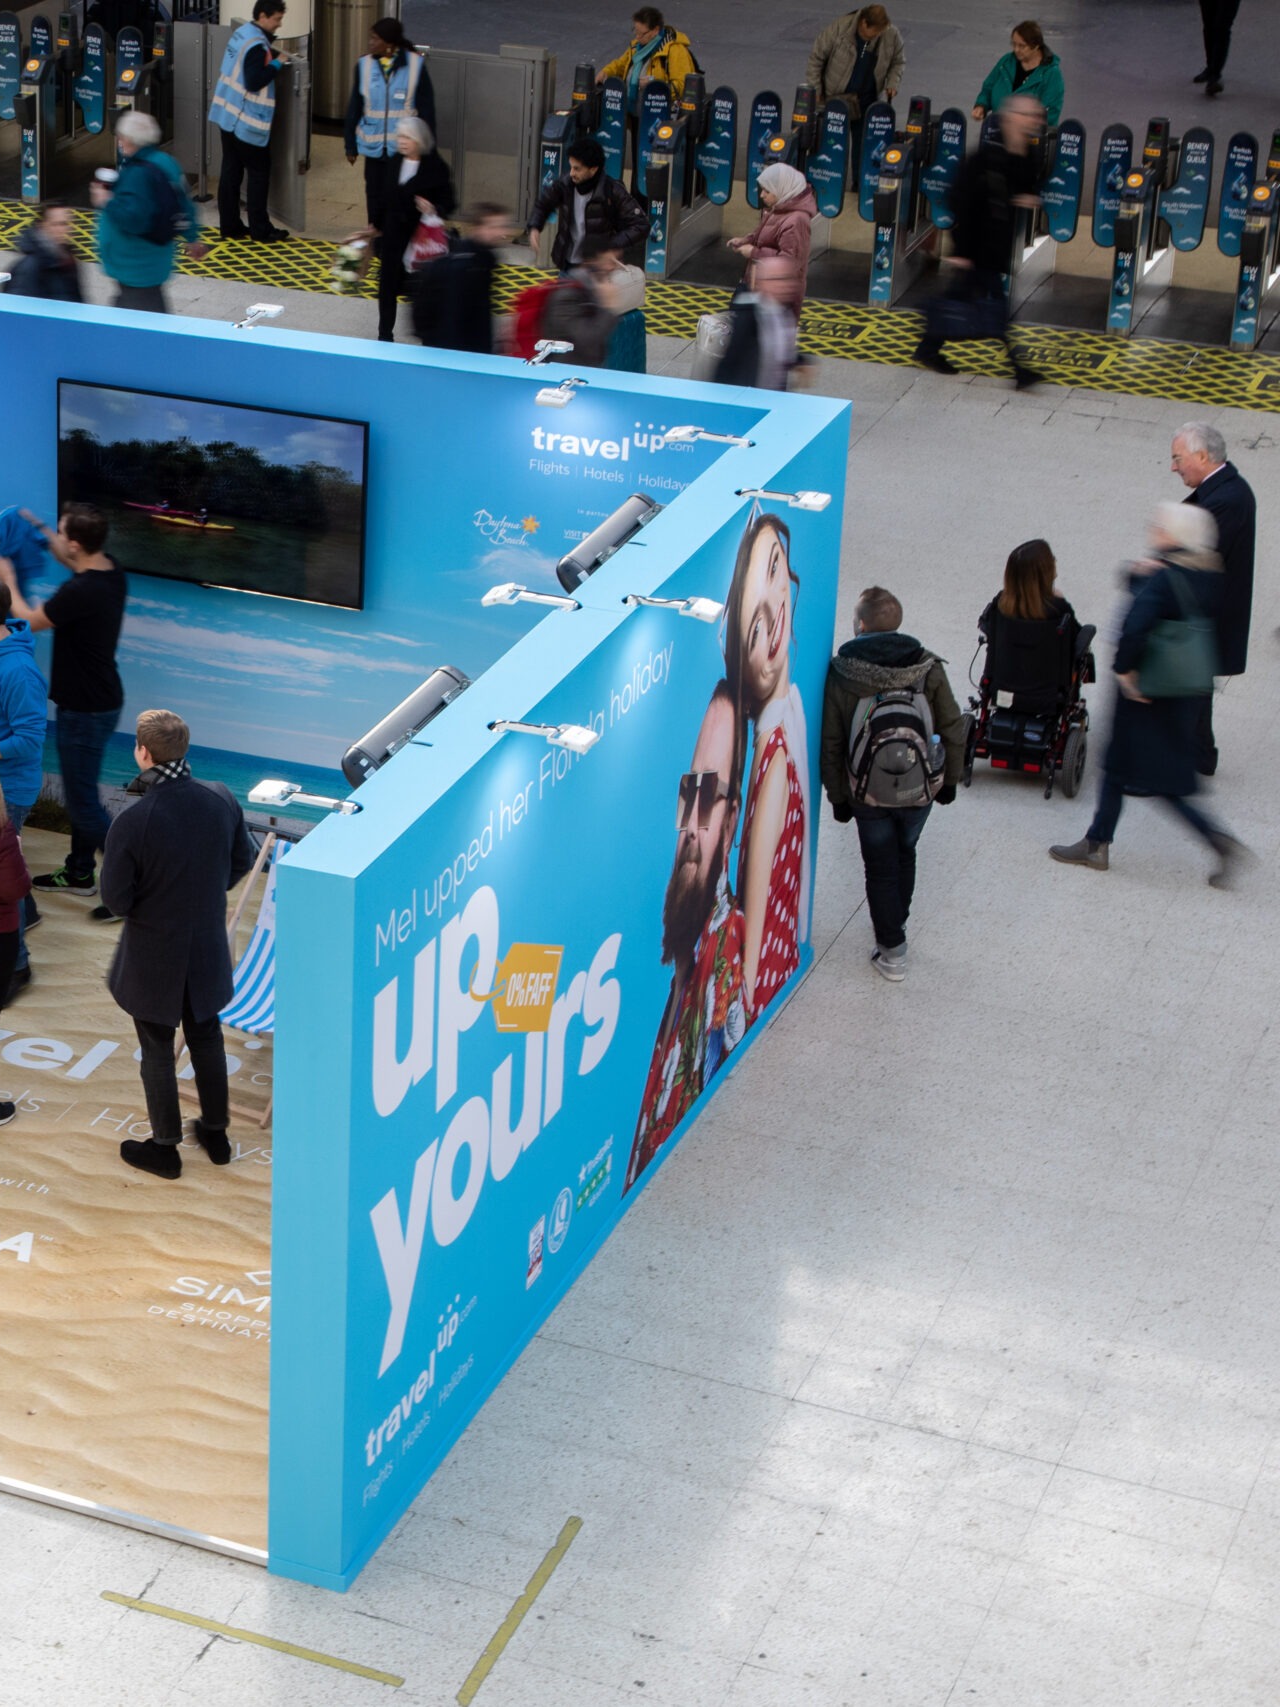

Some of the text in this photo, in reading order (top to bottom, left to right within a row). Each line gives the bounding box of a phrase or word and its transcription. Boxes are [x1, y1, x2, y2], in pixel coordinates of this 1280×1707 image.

[1186, 142, 1209, 151] RENEW
[544, 151, 557, 159] SW
[1186, 155, 1206, 164] QUEUE
[652, 200, 664, 208] SW
[1118, 252, 1132, 260] SW
[1243, 266, 1258, 274] SW
[805, 327, 851, 338] EAR
[1015, 353, 1093, 367] CLEAR
[1027, 347, 1091, 359] KEEP
[531, 426, 630, 461] travel
[529, 458, 570, 476] Flights
[583, 466, 625, 483] Hotels
[472, 509, 522, 535] Daytona
[489, 530, 530, 546] Beach
[564, 530, 582, 538] VISIT
[375, 888, 416, 967] Mel
[424, 811, 494, 918] upped
[500, 780, 534, 841] her
[610, 641, 674, 728] holiday
[372, 885, 499, 1117] up
[370, 934, 622, 1380] yours
[147, 1305, 271, 1343] DESTINAT
[180, 1302, 271, 1330] SHOPP
[365, 1349, 436, 1467] travel
[362, 1353, 475, 1508] Flights Hotels Holidays
